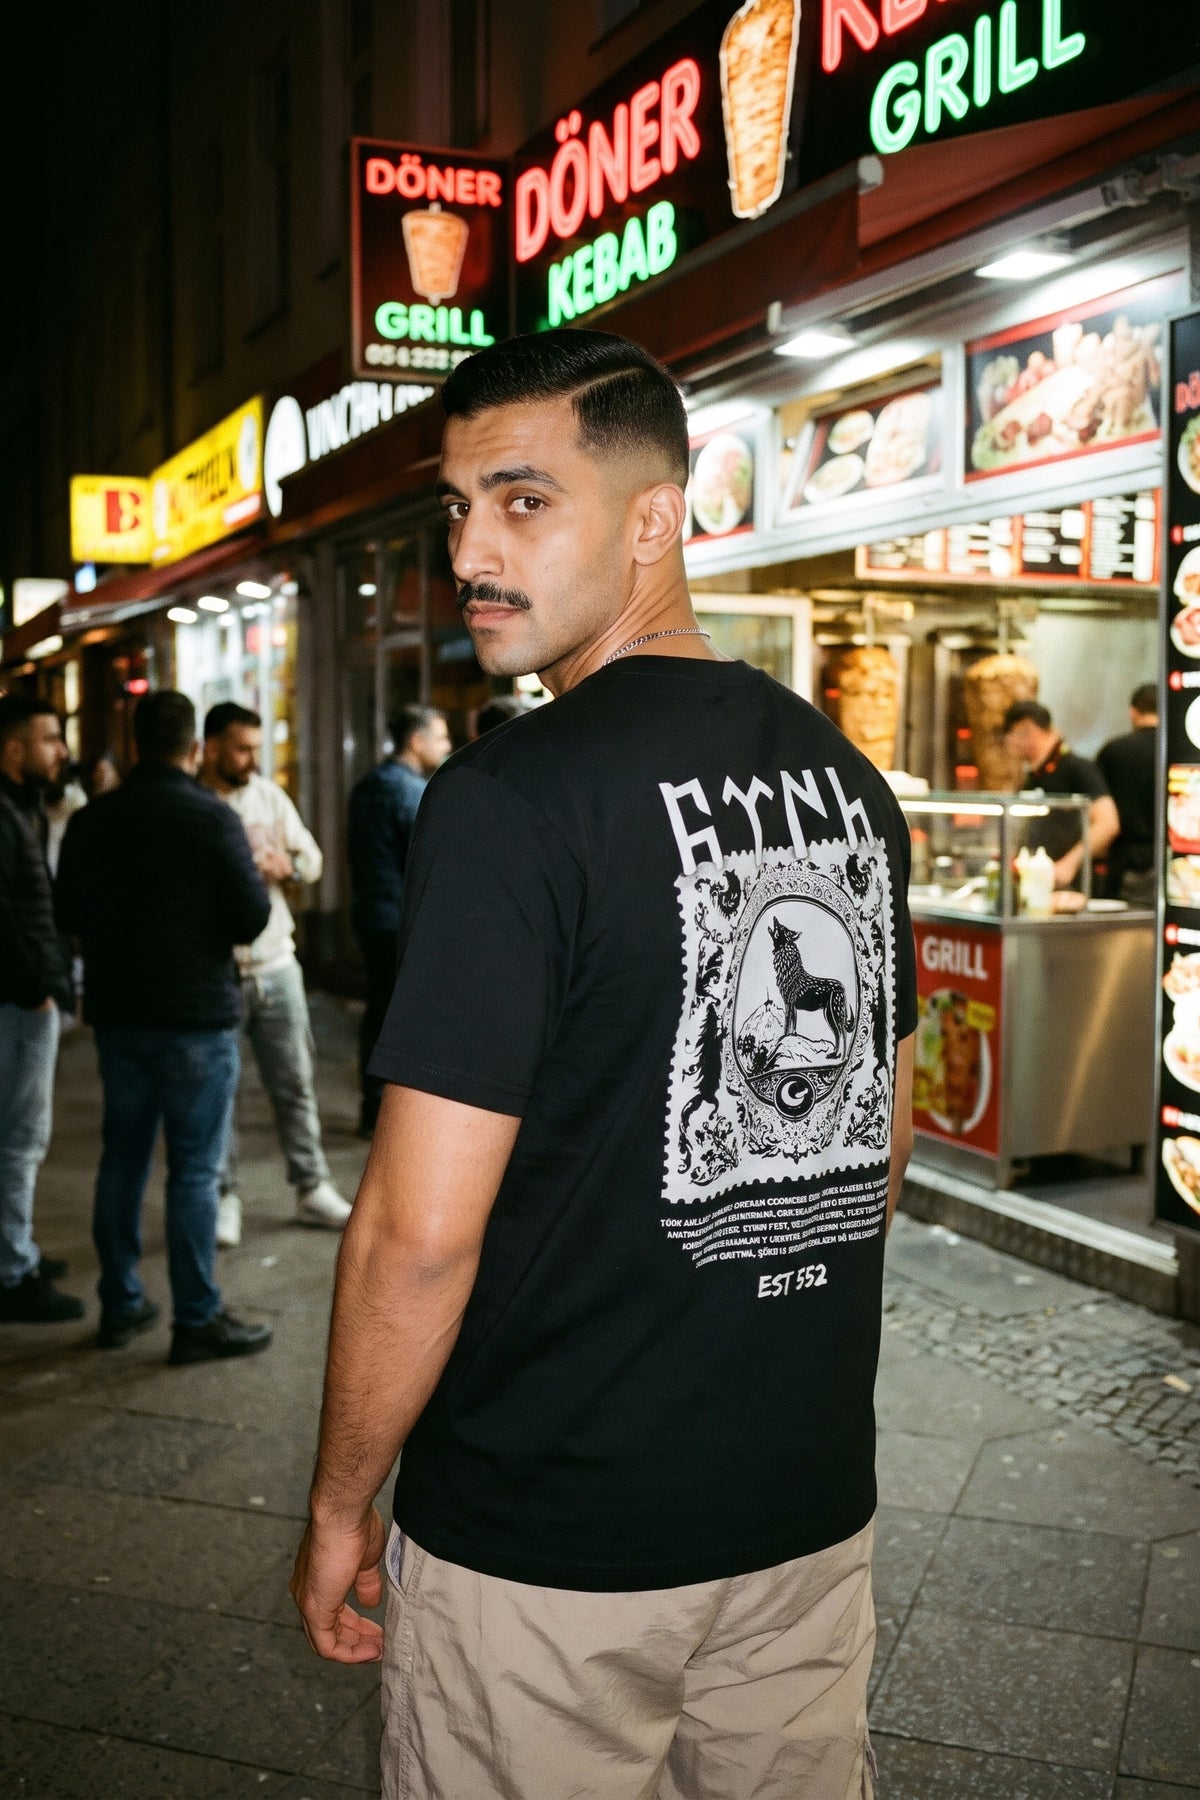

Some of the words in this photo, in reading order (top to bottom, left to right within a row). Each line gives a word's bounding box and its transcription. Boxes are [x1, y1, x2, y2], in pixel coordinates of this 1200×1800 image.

[869, 0, 1086, 155] GRILL
[365, 153, 503, 207] DÖNER
[514, 58, 701, 263] DÖNER
[544, 200, 677, 329] KEBAB
[374, 301, 495, 347] GRILL
[921, 935, 989, 981] GRILL
[757, 1271, 795, 1299] EST
[796, 1263, 828, 1291] 552
